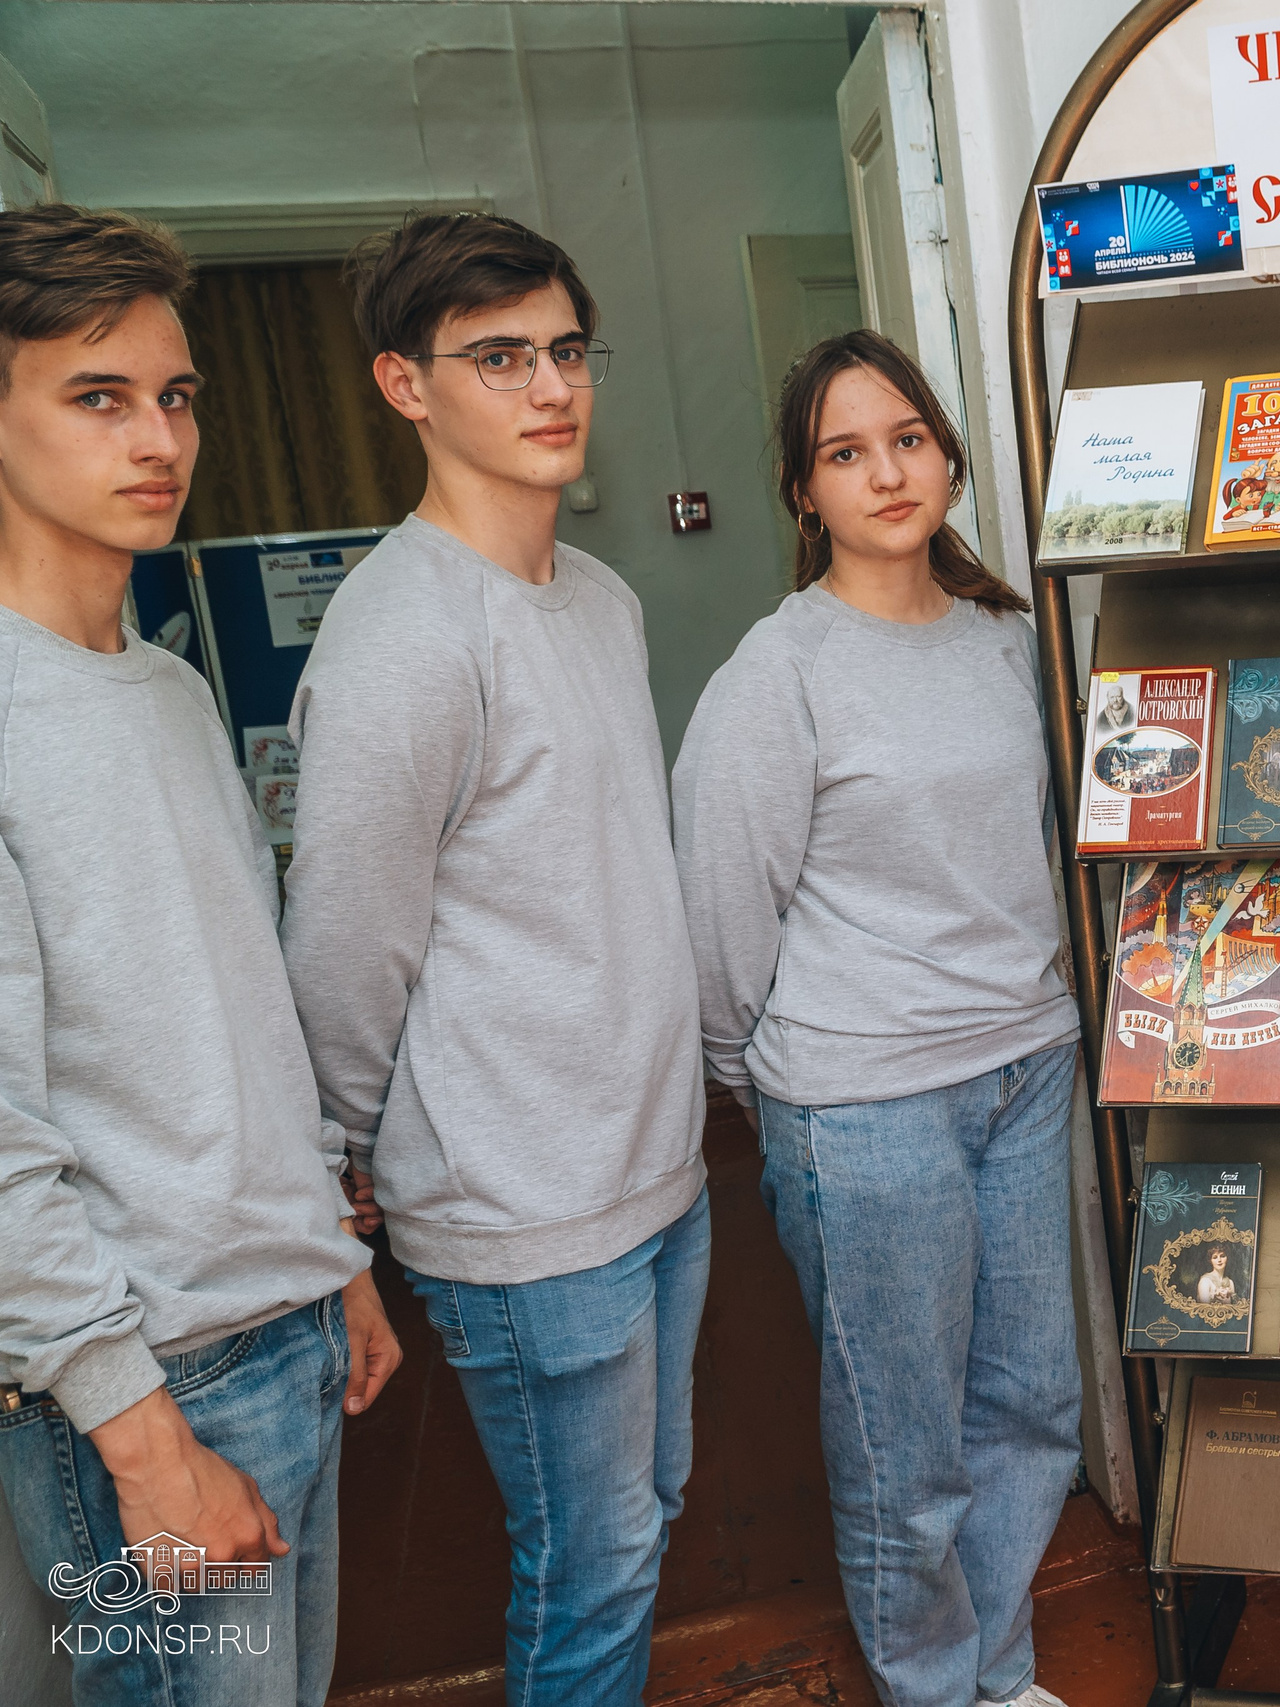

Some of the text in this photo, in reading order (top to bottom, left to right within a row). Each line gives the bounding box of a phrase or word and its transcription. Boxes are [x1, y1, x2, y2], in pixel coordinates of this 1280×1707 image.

[1108, 235, 1125, 248] 20
[1094, 247, 1126, 258] АПРЕЛЯ
[1095, 251, 1195, 271] БИБЛИОНОЧЬ 2024
[1082, 433, 1133, 447] Наша
[1093, 452, 1152, 464] малая
[1106, 466, 1174, 483] Родина
[1104, 537, 1123, 545] 2008
[266, 558, 280, 571] 20
[1144, 679, 1202, 699] АЛЕКСАНДР
[1139, 695, 1204, 721] ОСТРОВСКИЙ
[1145, 810, 1182, 822] Драматургия
[1210, 1005, 1239, 1016] СЕРГЕЙ
[1211, 1023, 1280, 1046] ДЛЯ ДЕТЕЙ
[1211, 1184, 1246, 1195] ЕСЕНИН
[1205, 1430, 1280, 1444] Ф. АБРАМОВ
[1206, 1443, 1238, 1454] Братья
[1247, 1447, 1280, 1458] сестры
